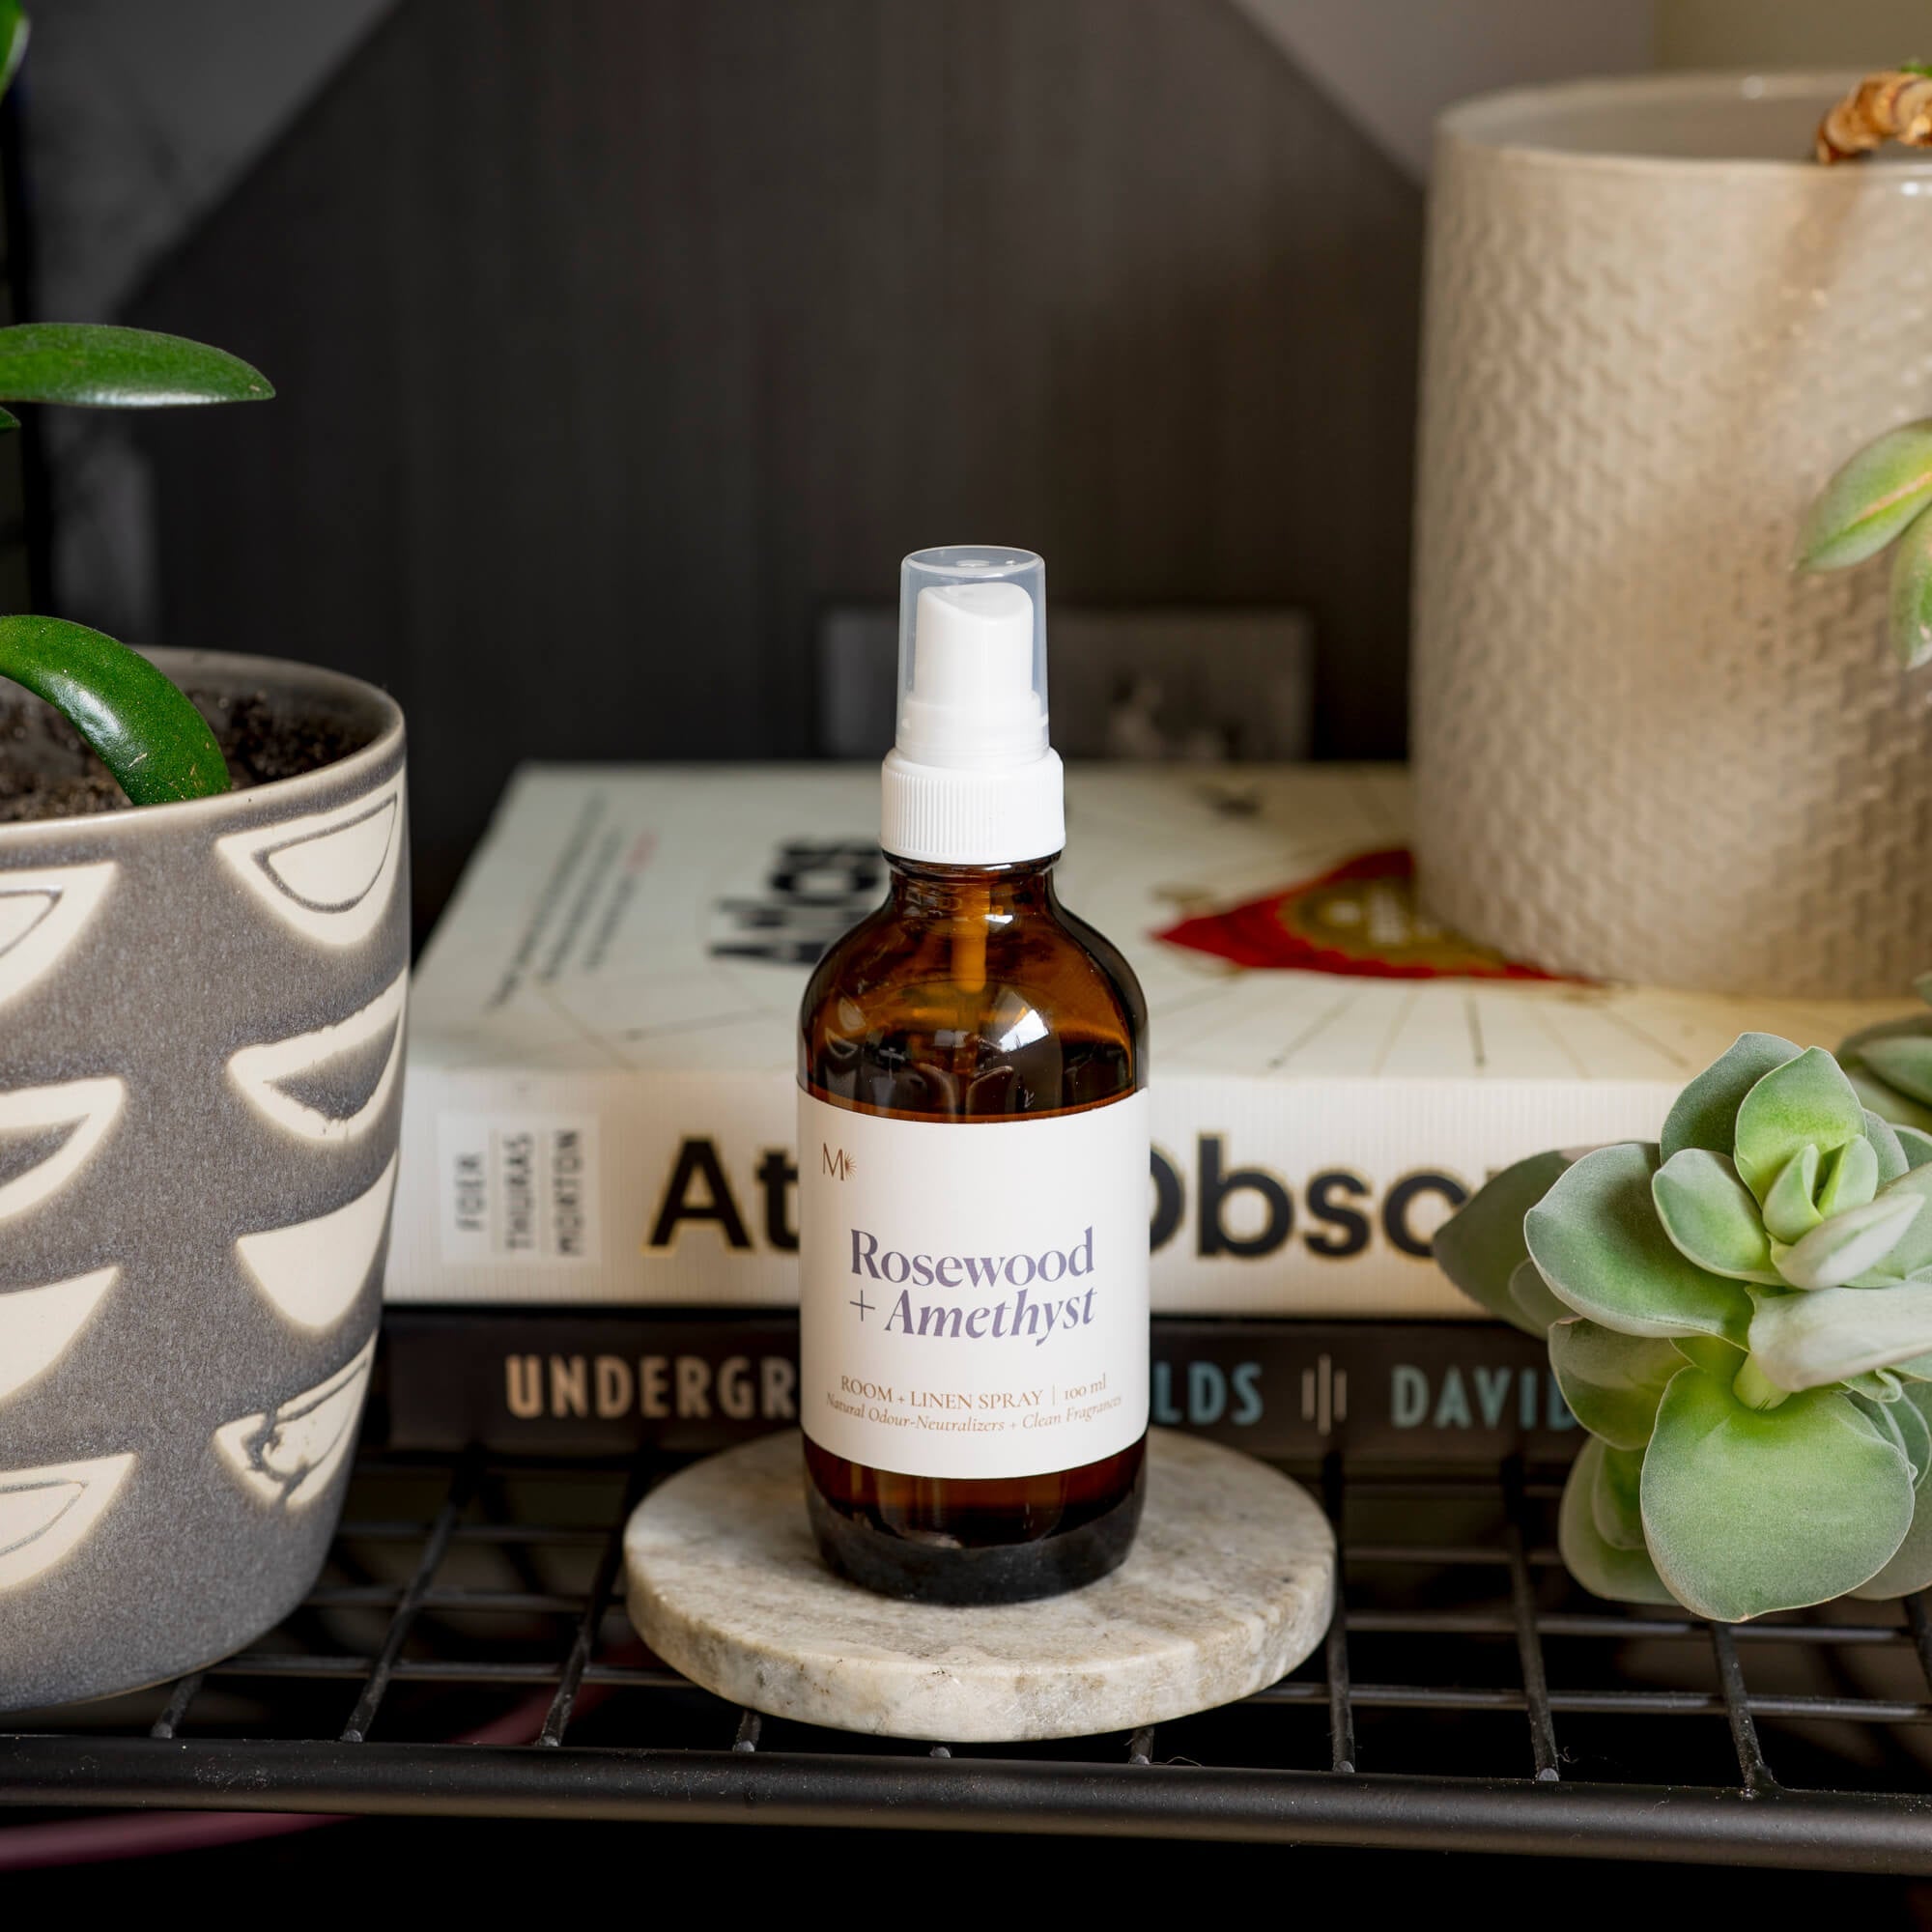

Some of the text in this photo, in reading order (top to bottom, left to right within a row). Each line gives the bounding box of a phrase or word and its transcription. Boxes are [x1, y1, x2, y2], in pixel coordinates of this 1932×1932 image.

[504, 1131, 534, 1250] THOMAS
[553, 1129, 584, 1256] MORTON
[647, 1136, 799, 1251] At
[850, 1225, 1095, 1288] Rosewood
[849, 1287, 1098, 1347] + Amethyst
[504, 1354, 798, 1420] UNDERGR
[1151, 1362, 1264, 1426] LDS
[826, 1392, 866, 1418] Natural
[1022, 1411, 1062, 1429] Clean
[840, 1375, 894, 1403] ROOM
[911, 1390, 973, 1410] LINEN
[979, 1389, 1043, 1409] SPRAY
[1065, 1386, 1087, 1400] 100
[1090, 1372, 1107, 1393] ml
